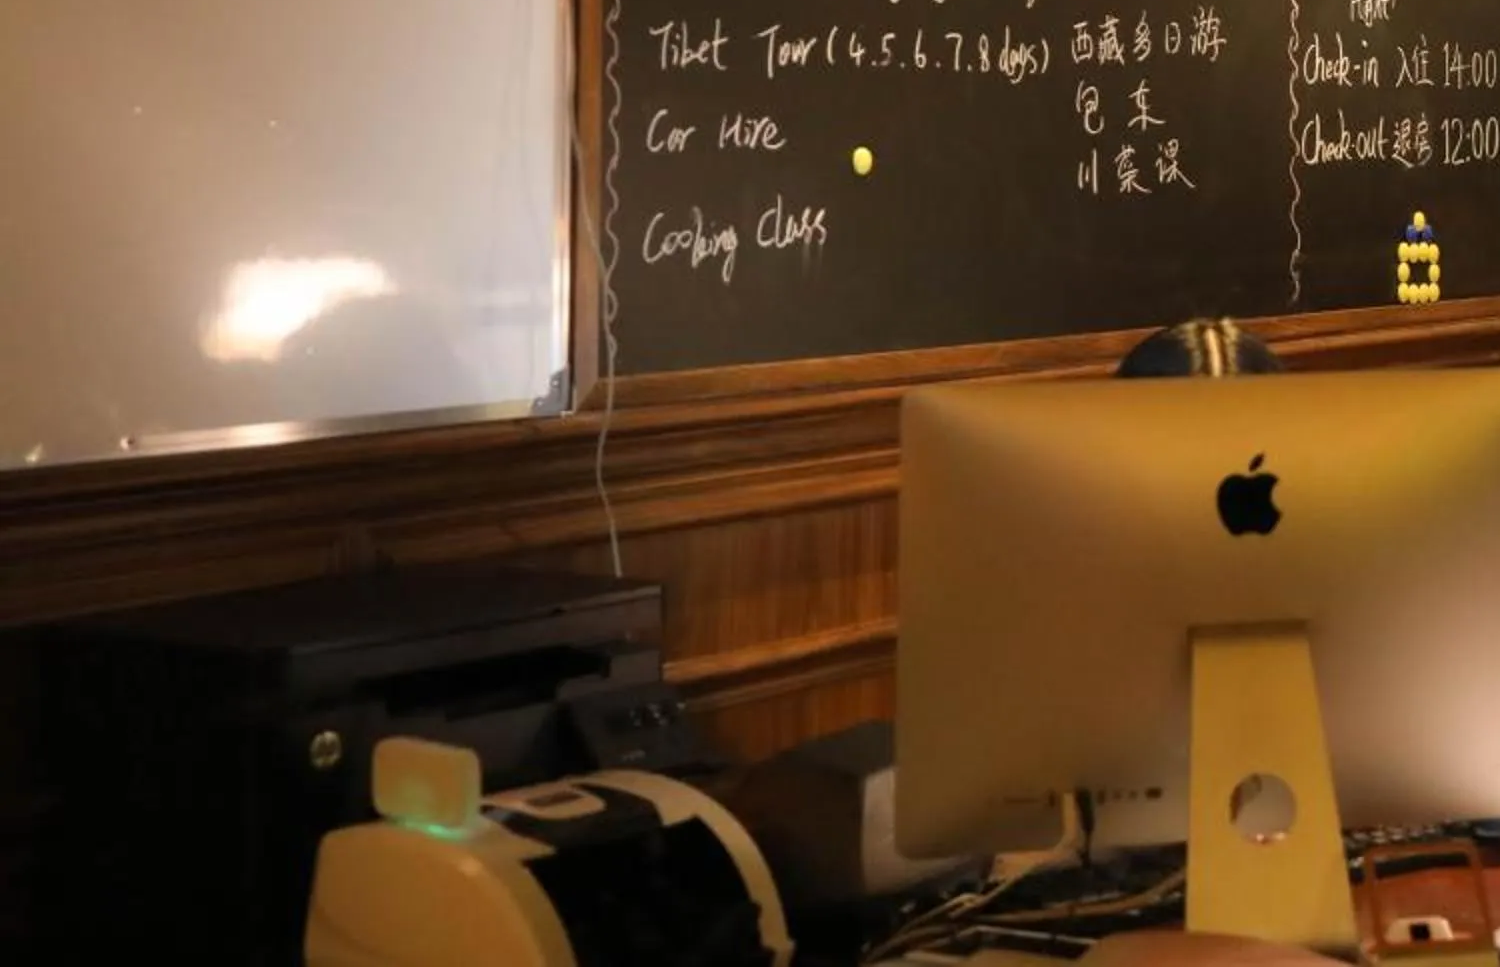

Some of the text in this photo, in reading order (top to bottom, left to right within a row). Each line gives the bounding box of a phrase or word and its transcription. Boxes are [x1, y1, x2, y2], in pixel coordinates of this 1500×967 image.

[650, 18, 729, 70] Tibet
[757, 24, 817, 79] Tour
[1071, 5, 1227, 66] 西藏多日游
[719, 113, 786, 150] Hire
[1440, 116, 1500, 166] 12:00
